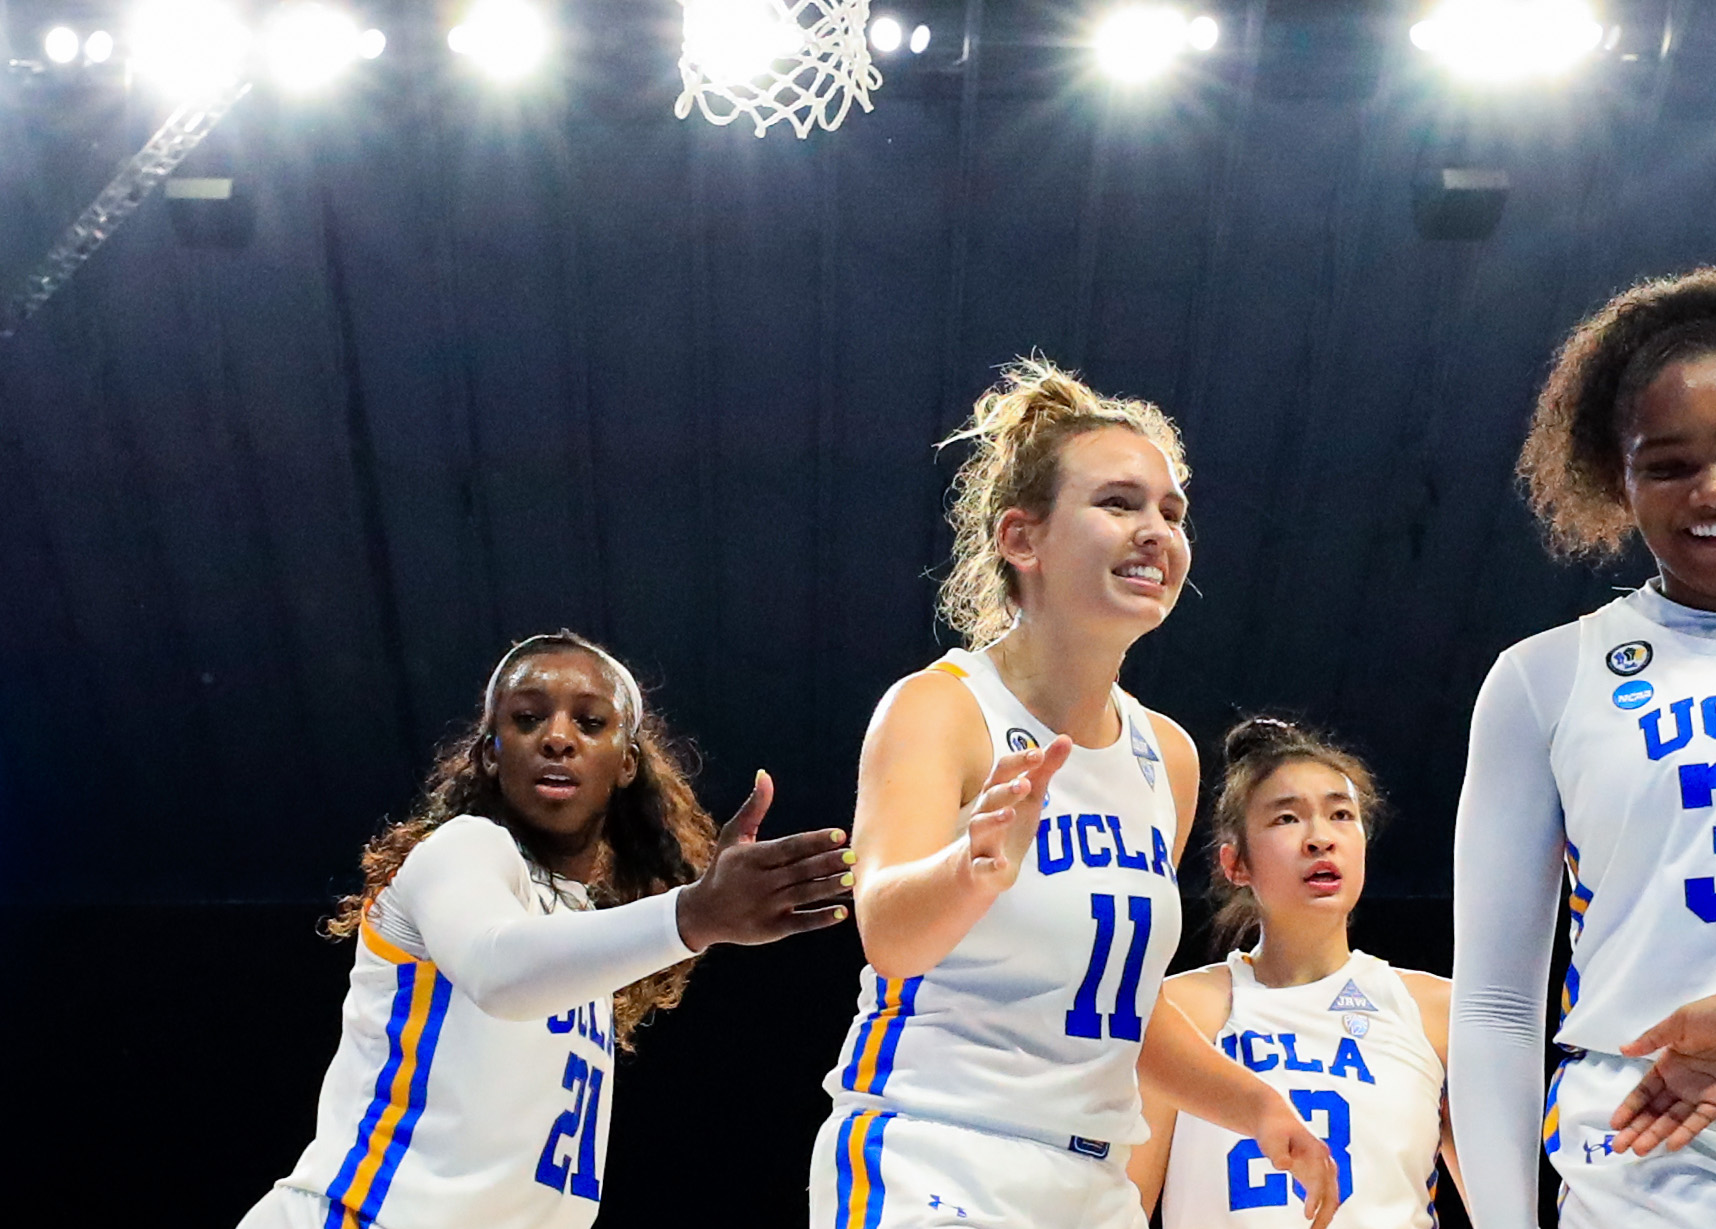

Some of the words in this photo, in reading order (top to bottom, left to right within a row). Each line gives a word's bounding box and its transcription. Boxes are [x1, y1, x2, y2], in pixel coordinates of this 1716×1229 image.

[1036, 813, 1178, 885] UCLA
[1065, 893, 1152, 1042] 11
[535, 1050, 605, 1202] 21
[1227, 1088, 1354, 1212] 23
